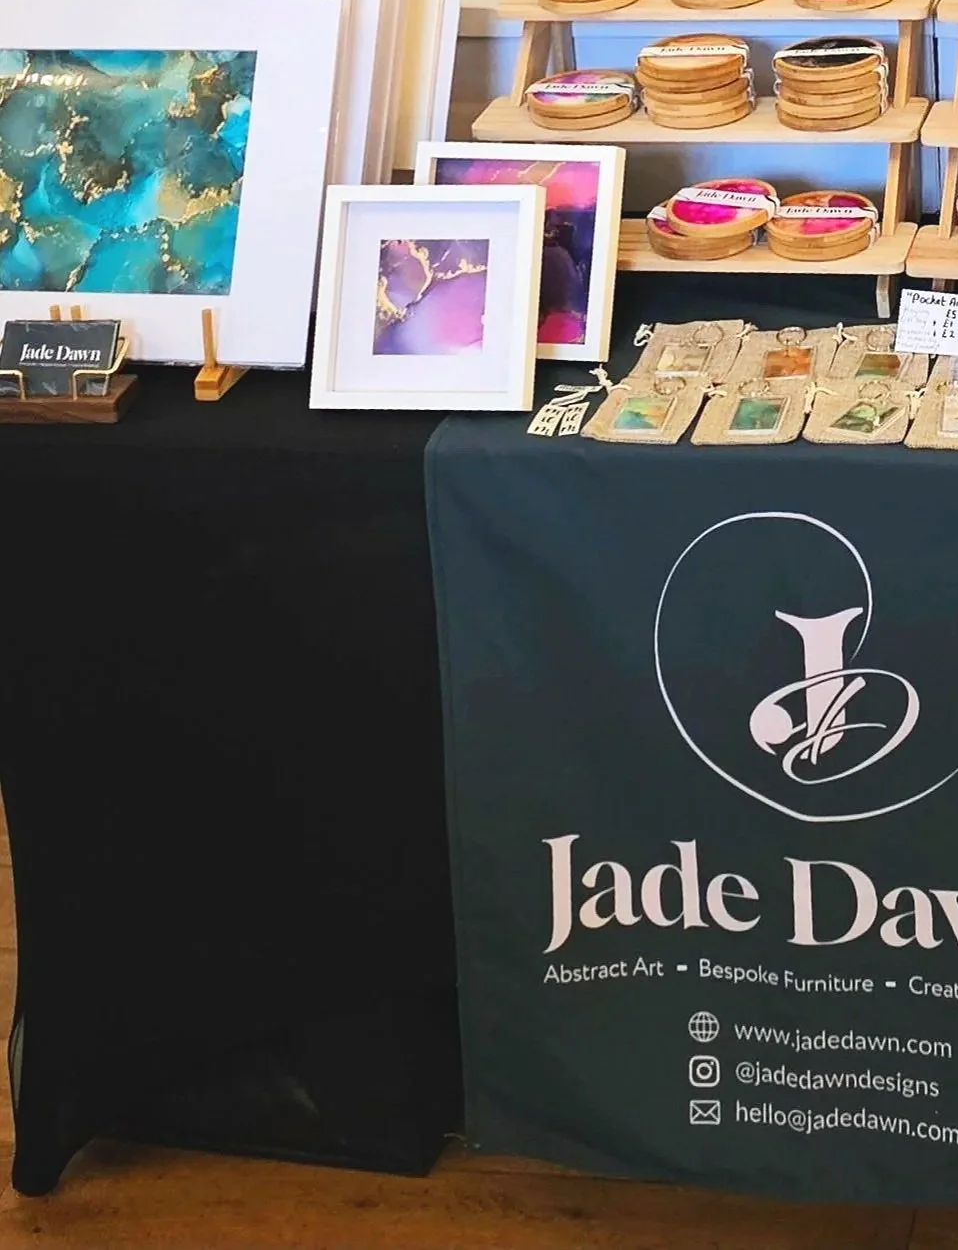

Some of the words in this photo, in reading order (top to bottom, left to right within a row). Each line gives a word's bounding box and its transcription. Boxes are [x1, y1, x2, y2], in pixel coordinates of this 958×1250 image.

[20, 343, 54, 362] Jade
[56, 345, 101, 361] Dawn
[541, 833, 761, 954] Jade
[543, 959, 628, 984] Abstract
[632, 956, 665, 977] Art
[699, 957, 779, 986] Bespoke
[783, 969, 875, 994] Furniture
[733, 1023, 954, 1059] www.jadedawn.com
[734, 1061, 941, 1098] @jadedawndesigns
